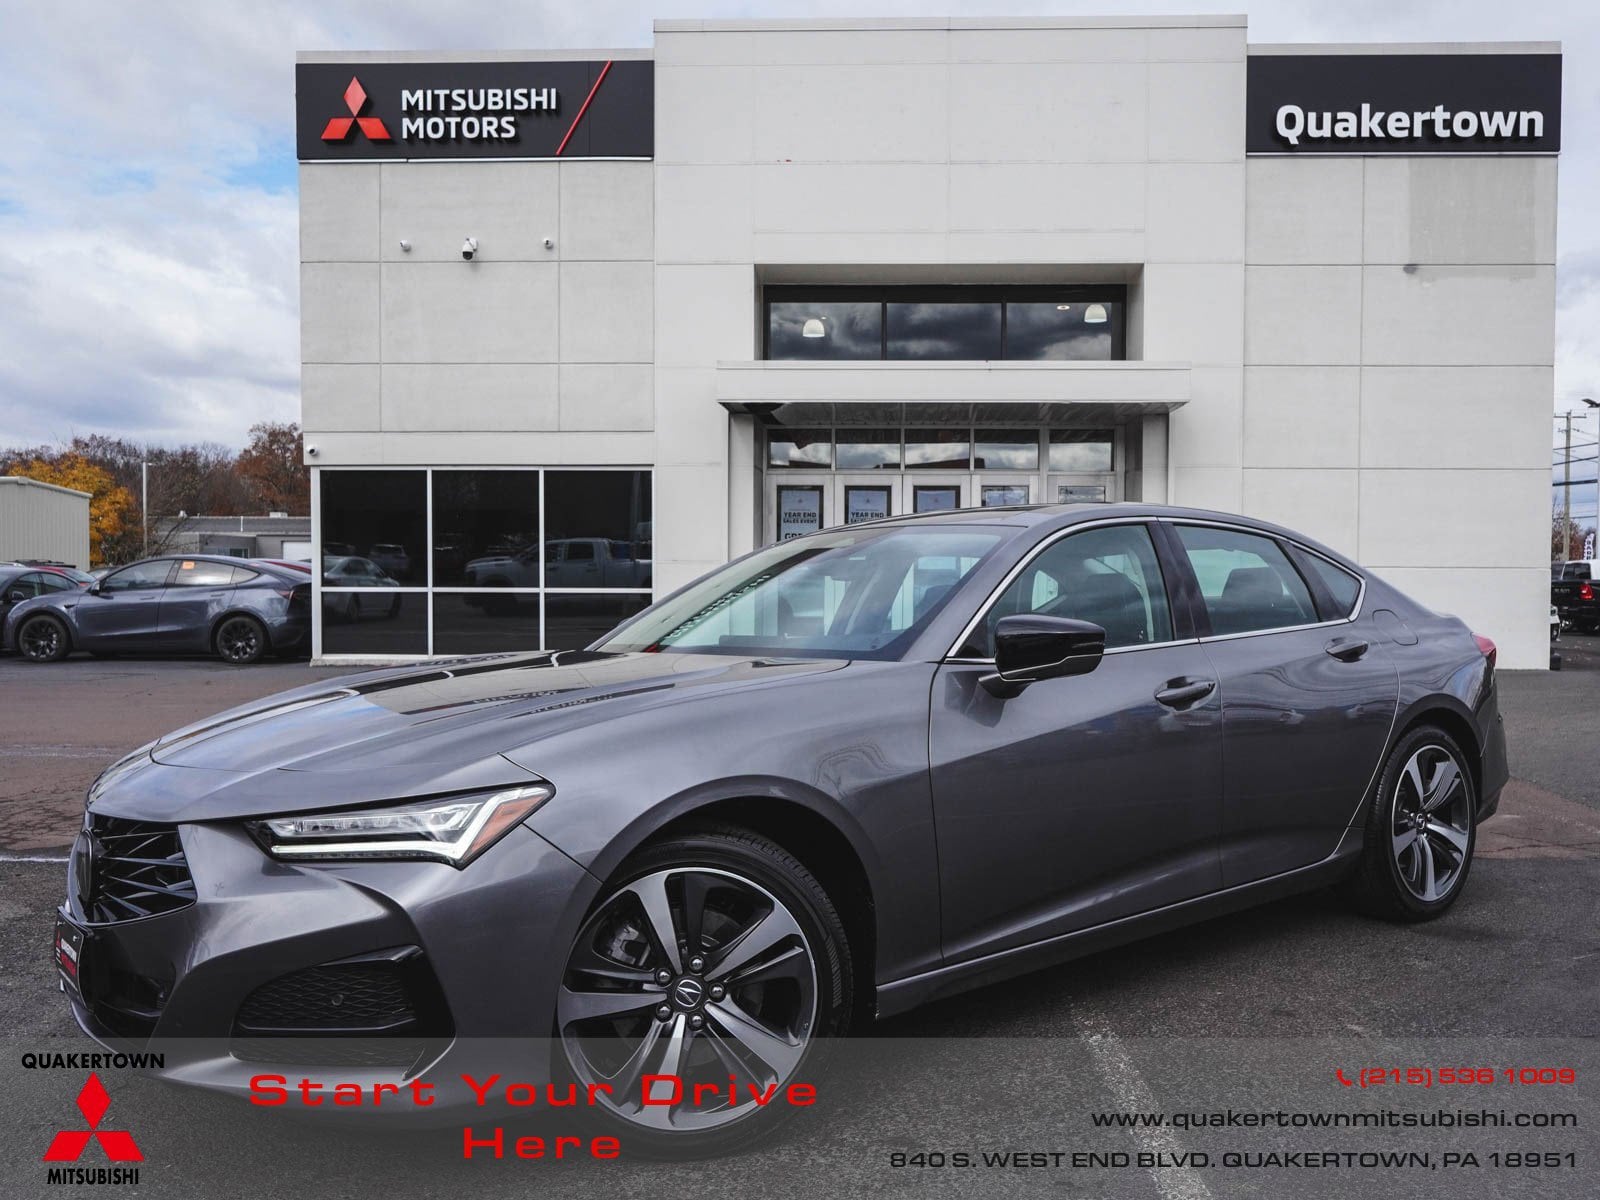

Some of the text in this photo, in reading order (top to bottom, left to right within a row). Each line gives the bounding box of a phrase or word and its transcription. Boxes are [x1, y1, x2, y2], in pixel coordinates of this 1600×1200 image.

[401, 87, 557, 111] MITSUBISHI
[402, 116, 516, 140] MOTORS
[1276, 103, 1544, 145] Quakertown
